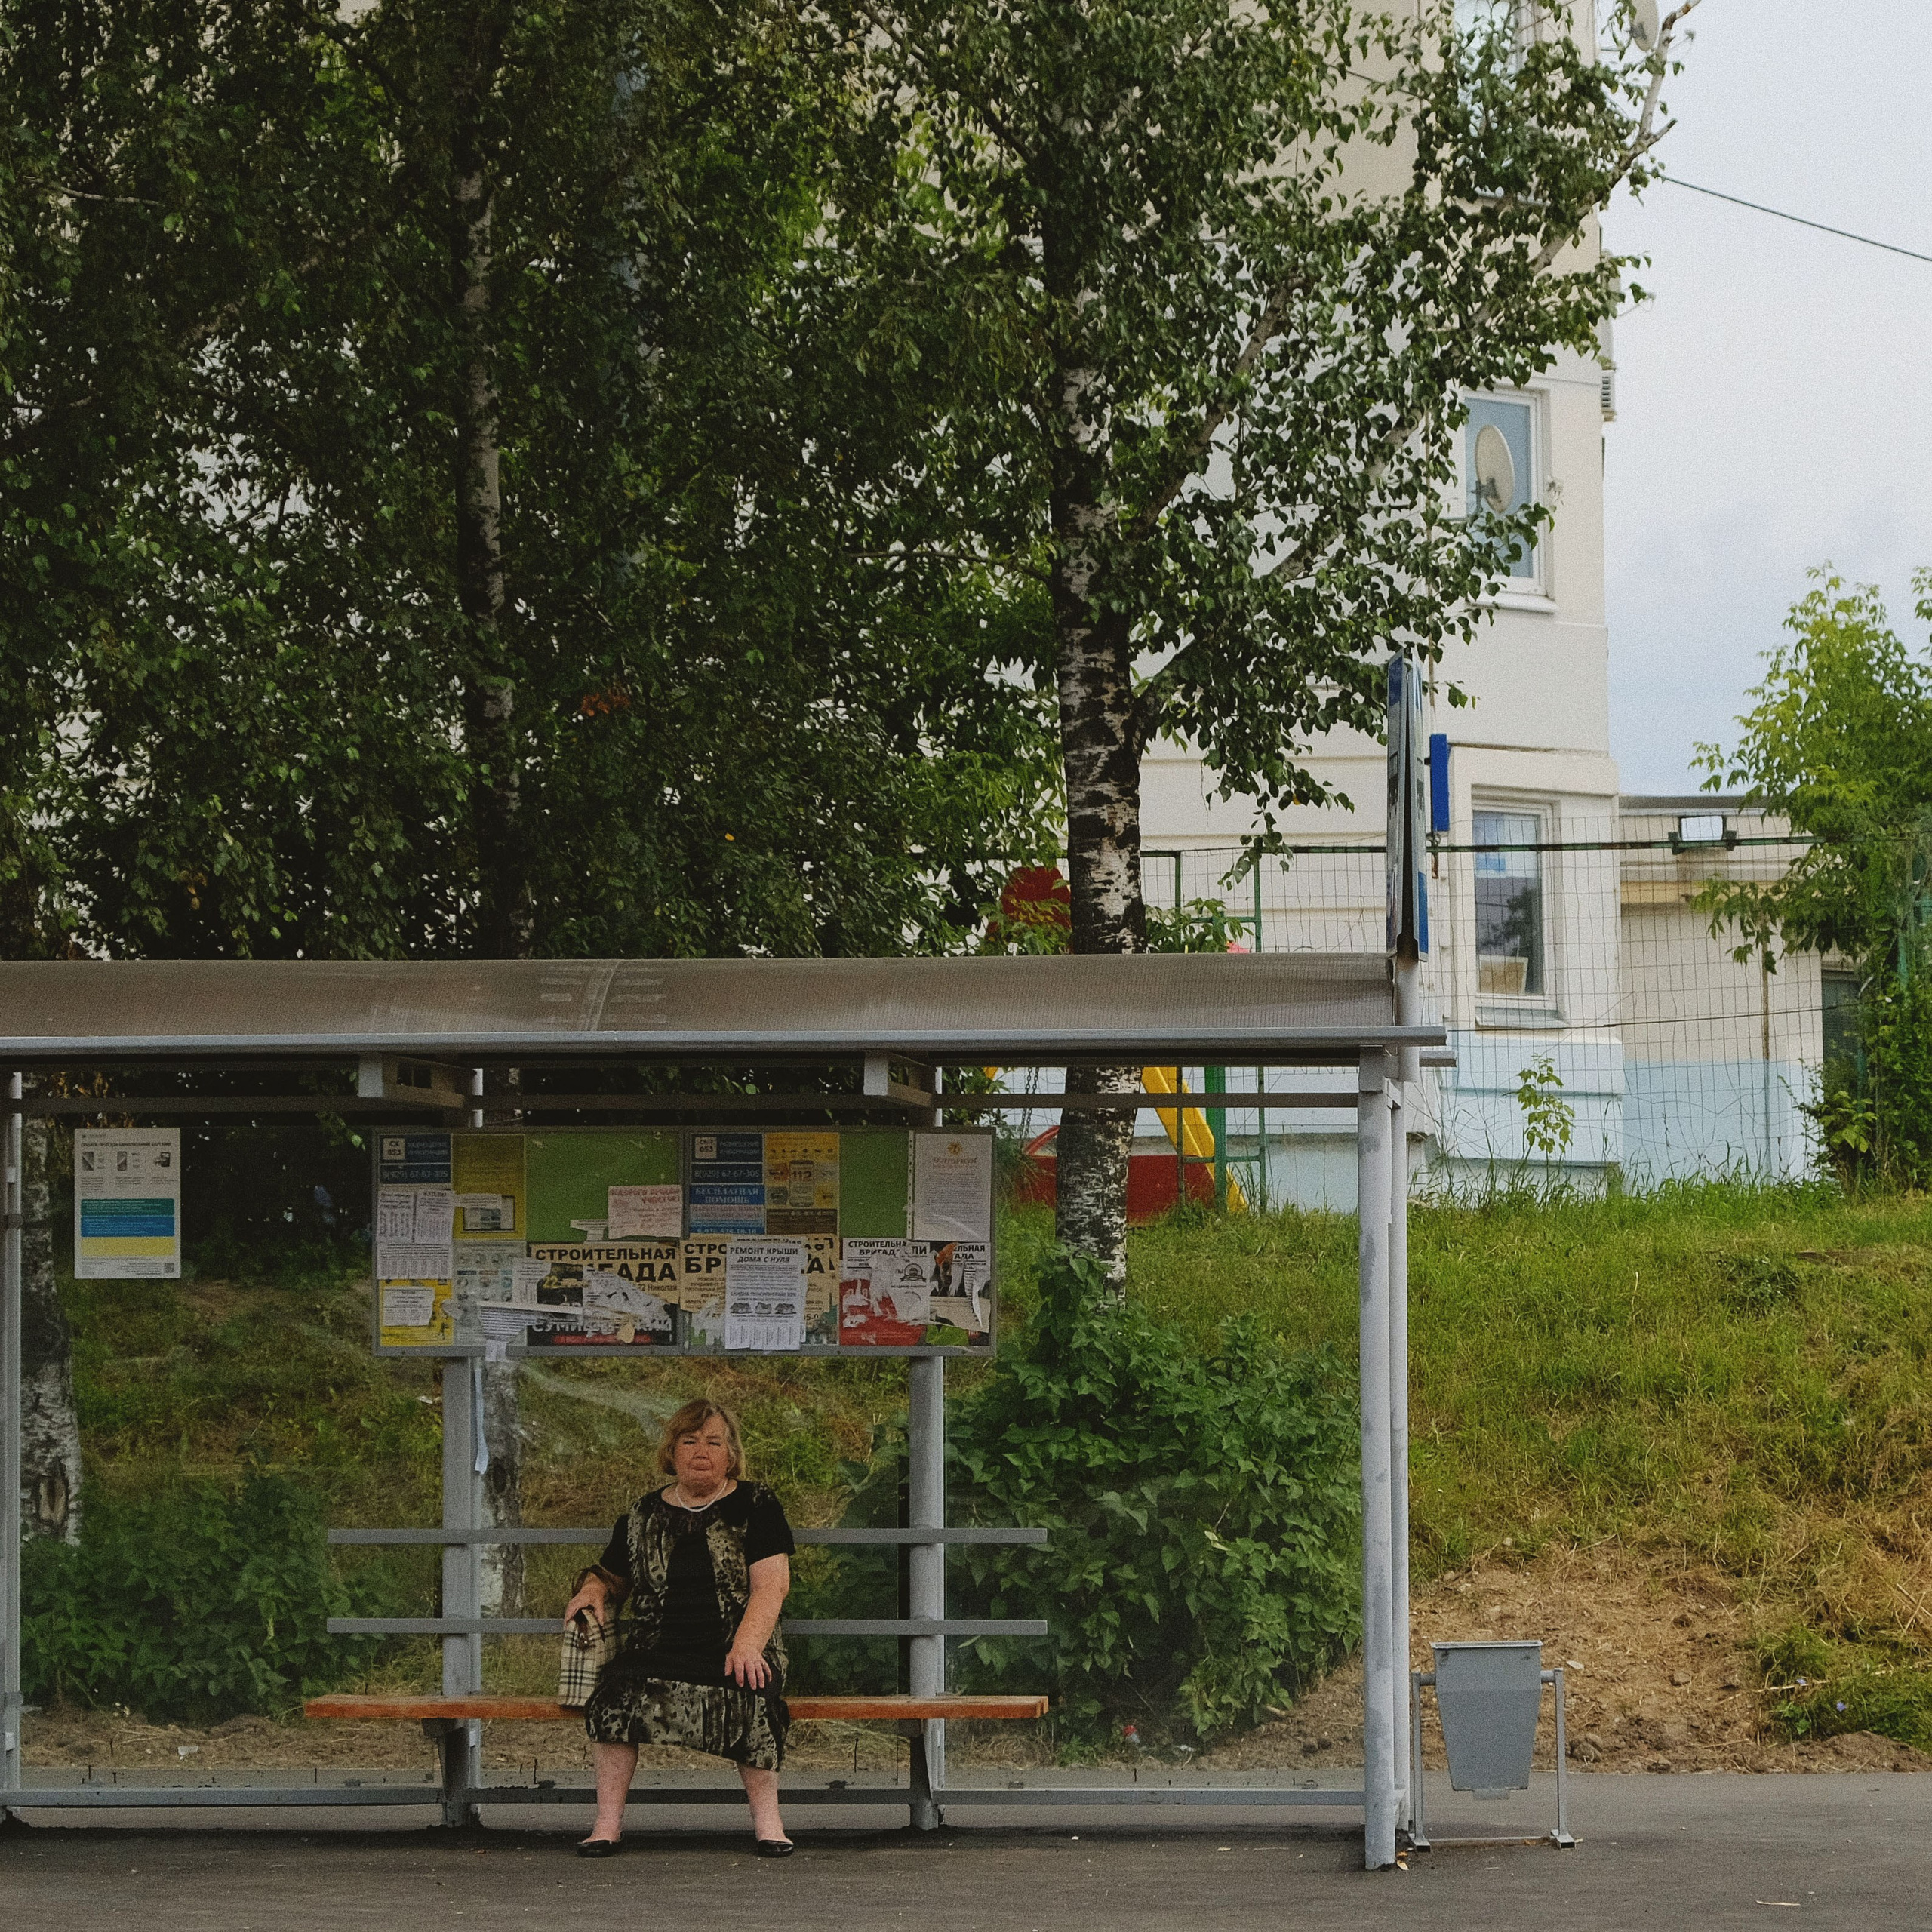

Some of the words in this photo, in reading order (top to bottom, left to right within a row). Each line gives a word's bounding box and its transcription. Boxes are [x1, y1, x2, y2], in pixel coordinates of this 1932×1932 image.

[792, 1171, 812, 1181] 112
[535, 1247, 676, 1261] СТРОИТЕЛЬНАЯ
[859, 1249, 900, 1257] БРИГАД
[648, 1283, 677, 1291] Николай
